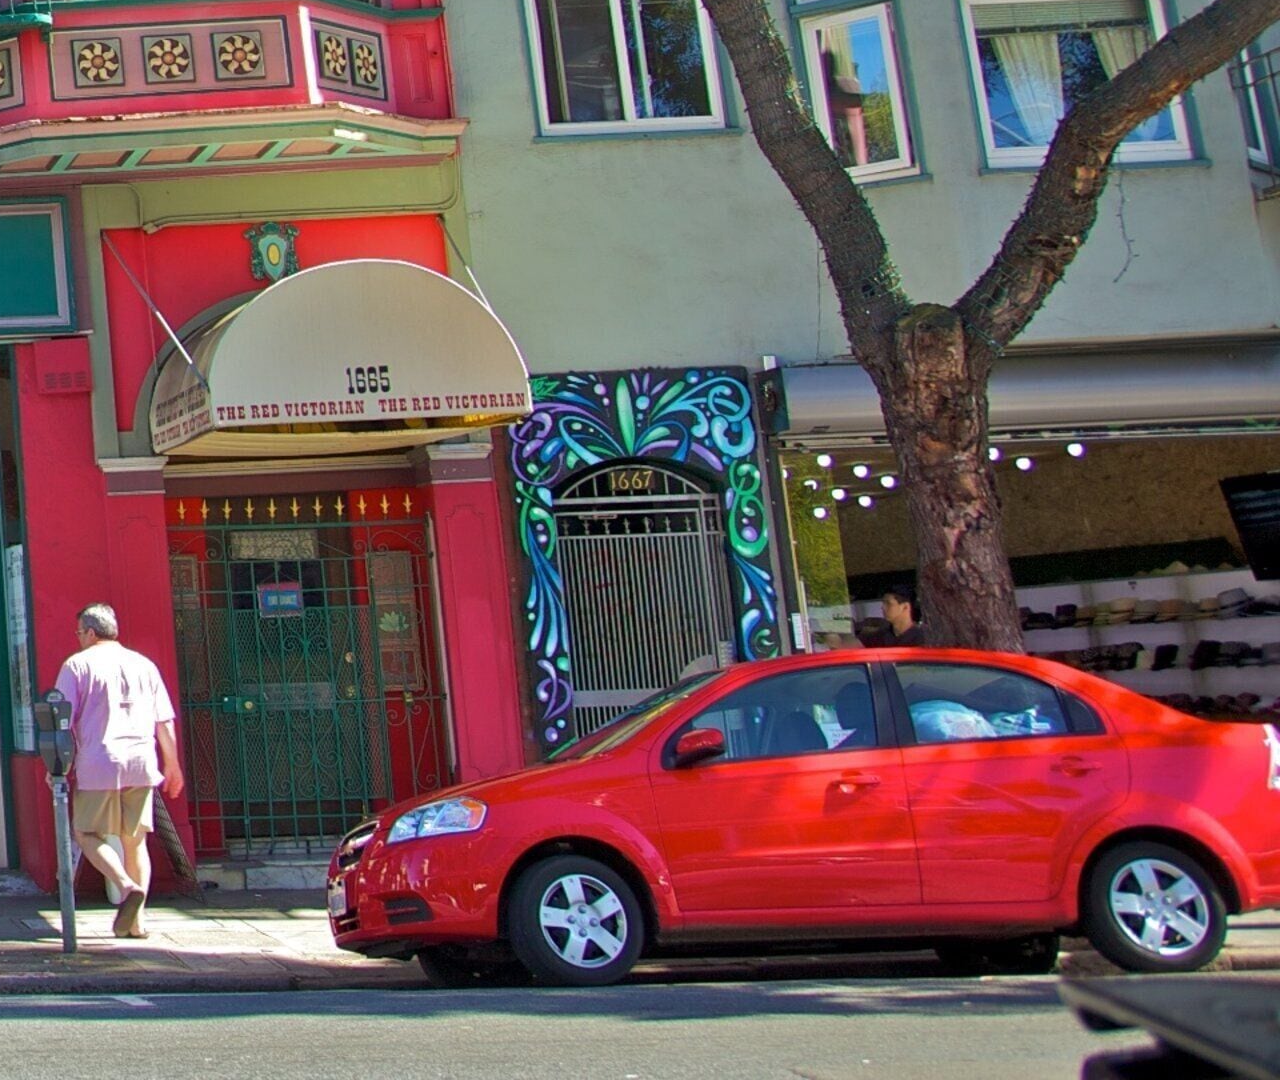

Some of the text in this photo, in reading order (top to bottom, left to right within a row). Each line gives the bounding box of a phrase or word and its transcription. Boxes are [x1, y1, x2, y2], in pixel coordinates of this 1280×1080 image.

[346, 366, 391, 395] 1665
[217, 392, 525, 421] THE RED VICTORIAN THE RED VICTORIAN
[610, 470, 653, 490] 1667
